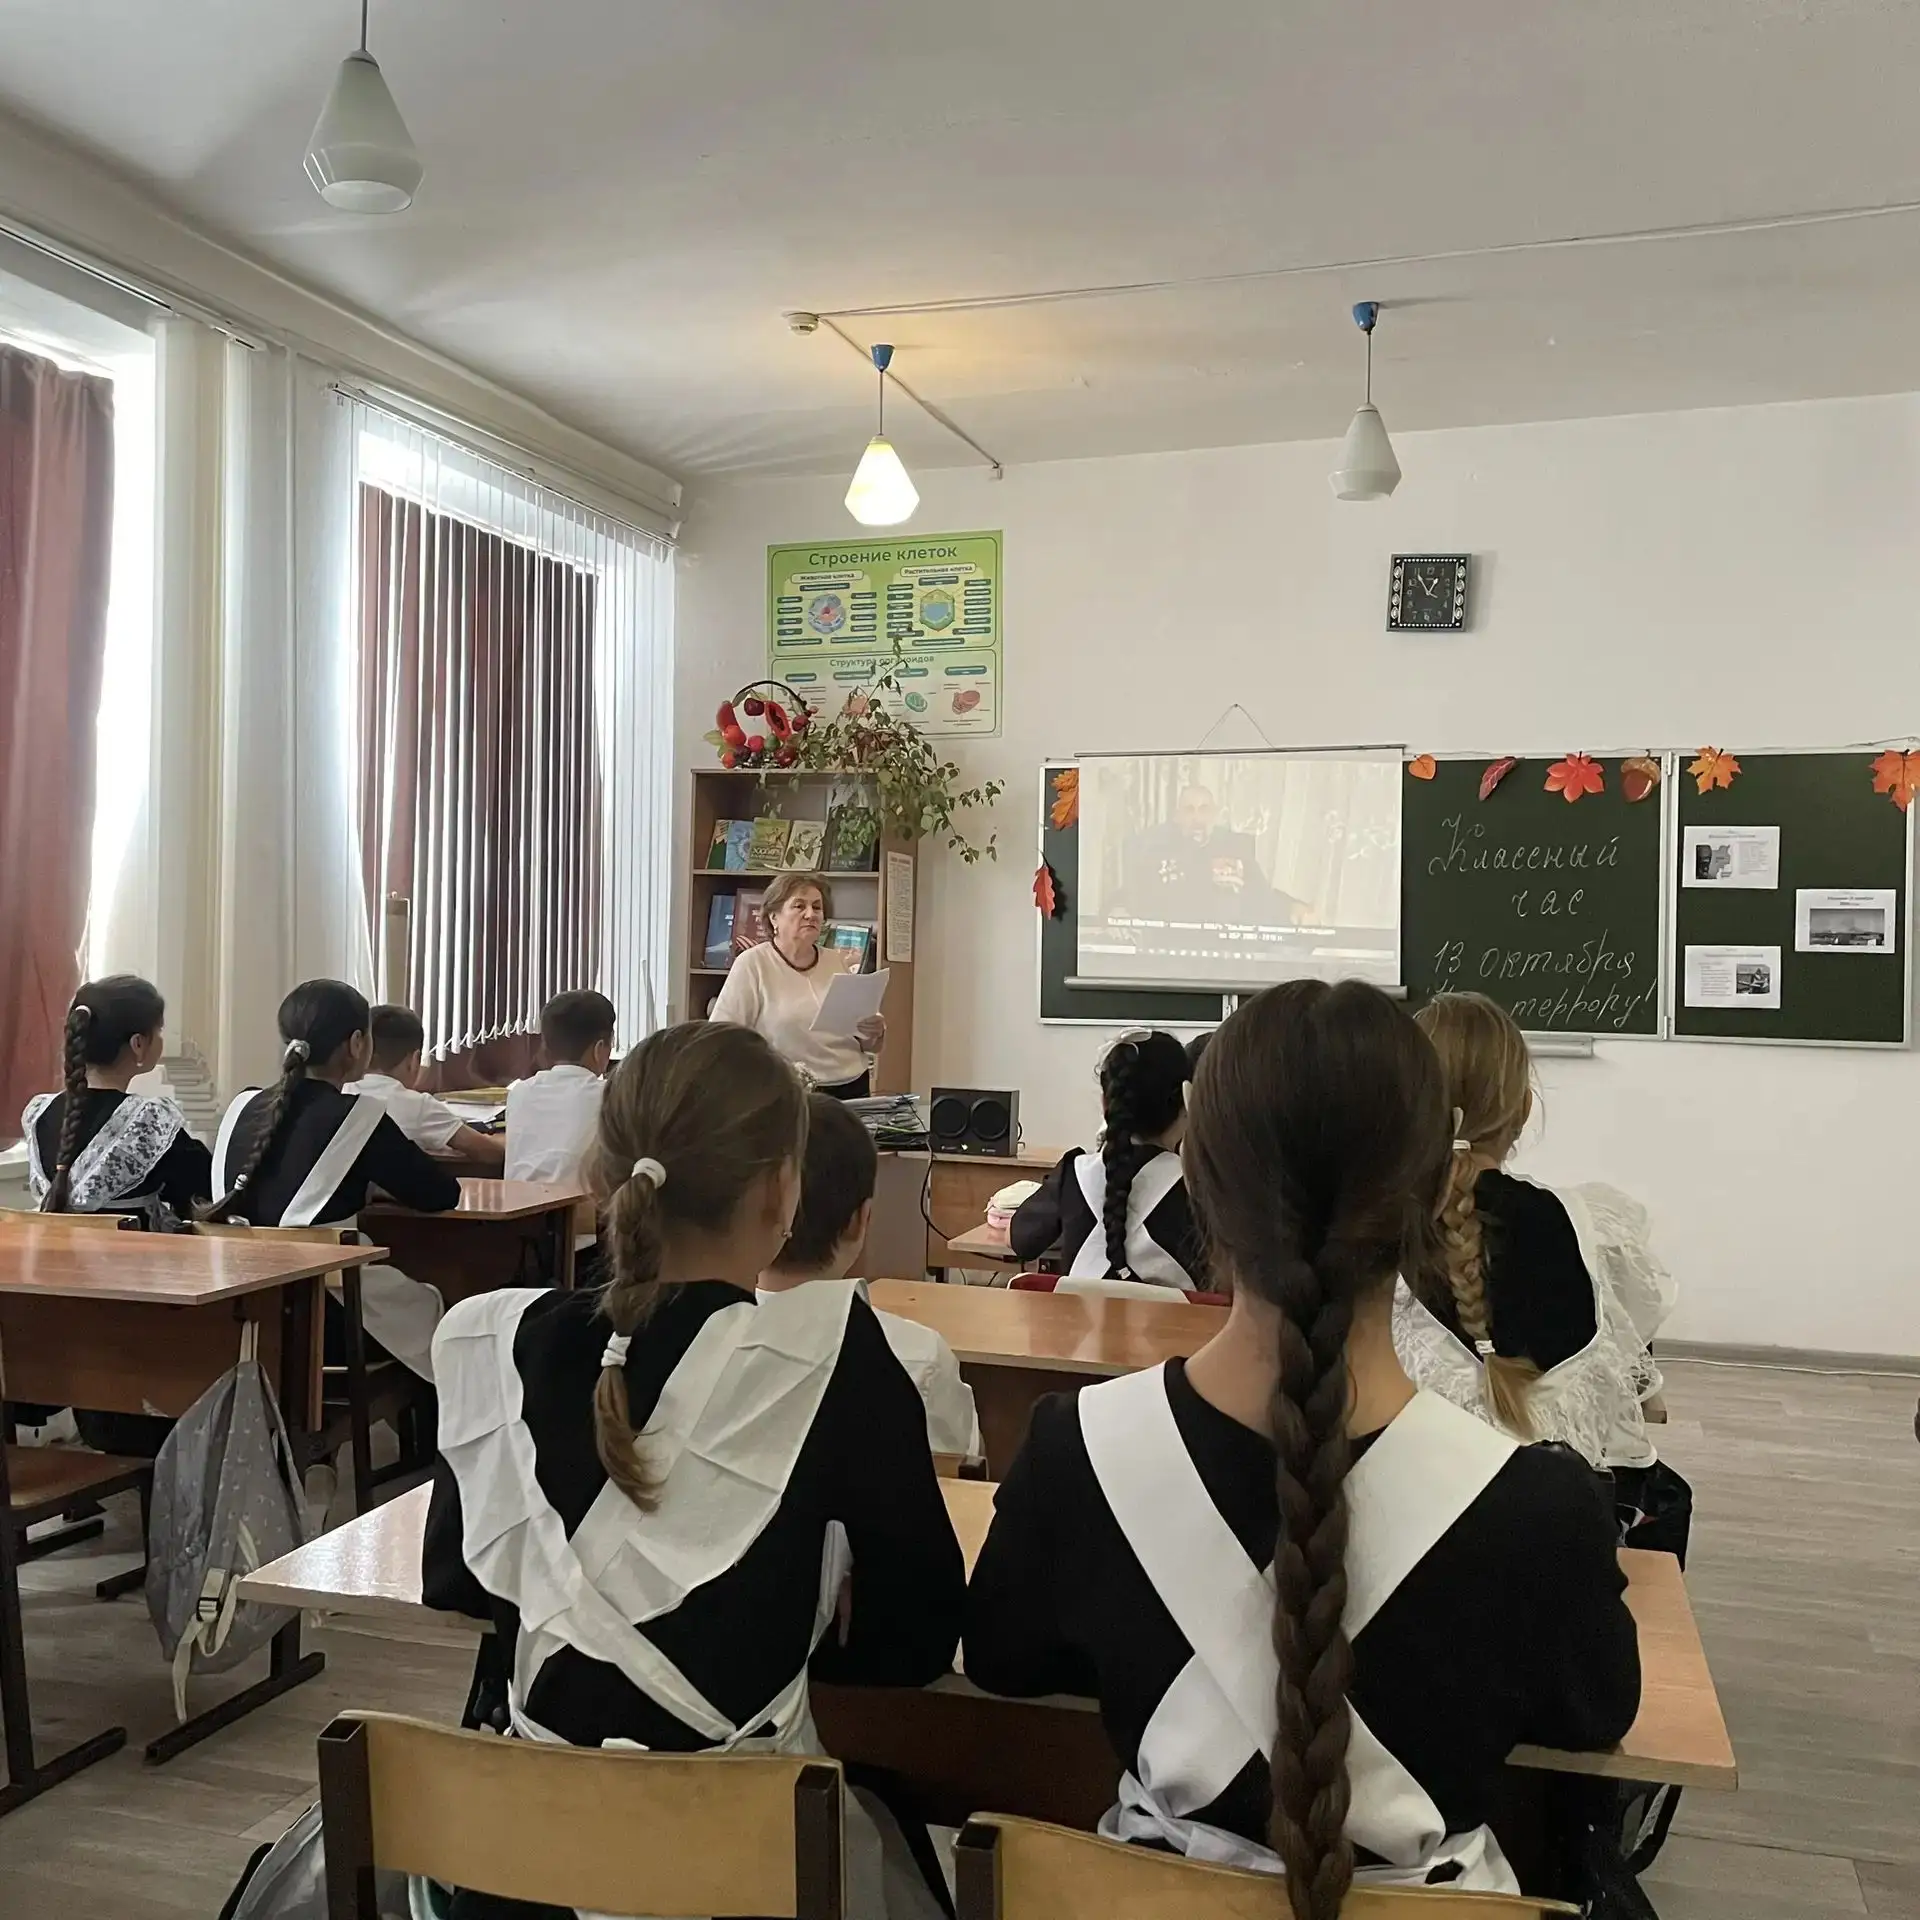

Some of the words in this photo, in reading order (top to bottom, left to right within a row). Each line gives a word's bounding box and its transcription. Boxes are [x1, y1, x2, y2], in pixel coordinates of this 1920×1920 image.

[809, 551, 892, 568] Строение
[897, 546, 957, 561] клеток
[1429, 813, 1620, 875] Классный
[1512, 889, 1584, 917] час
[1435, 940, 1465, 974] 13
[1509, 977, 1657, 1028] террору!
